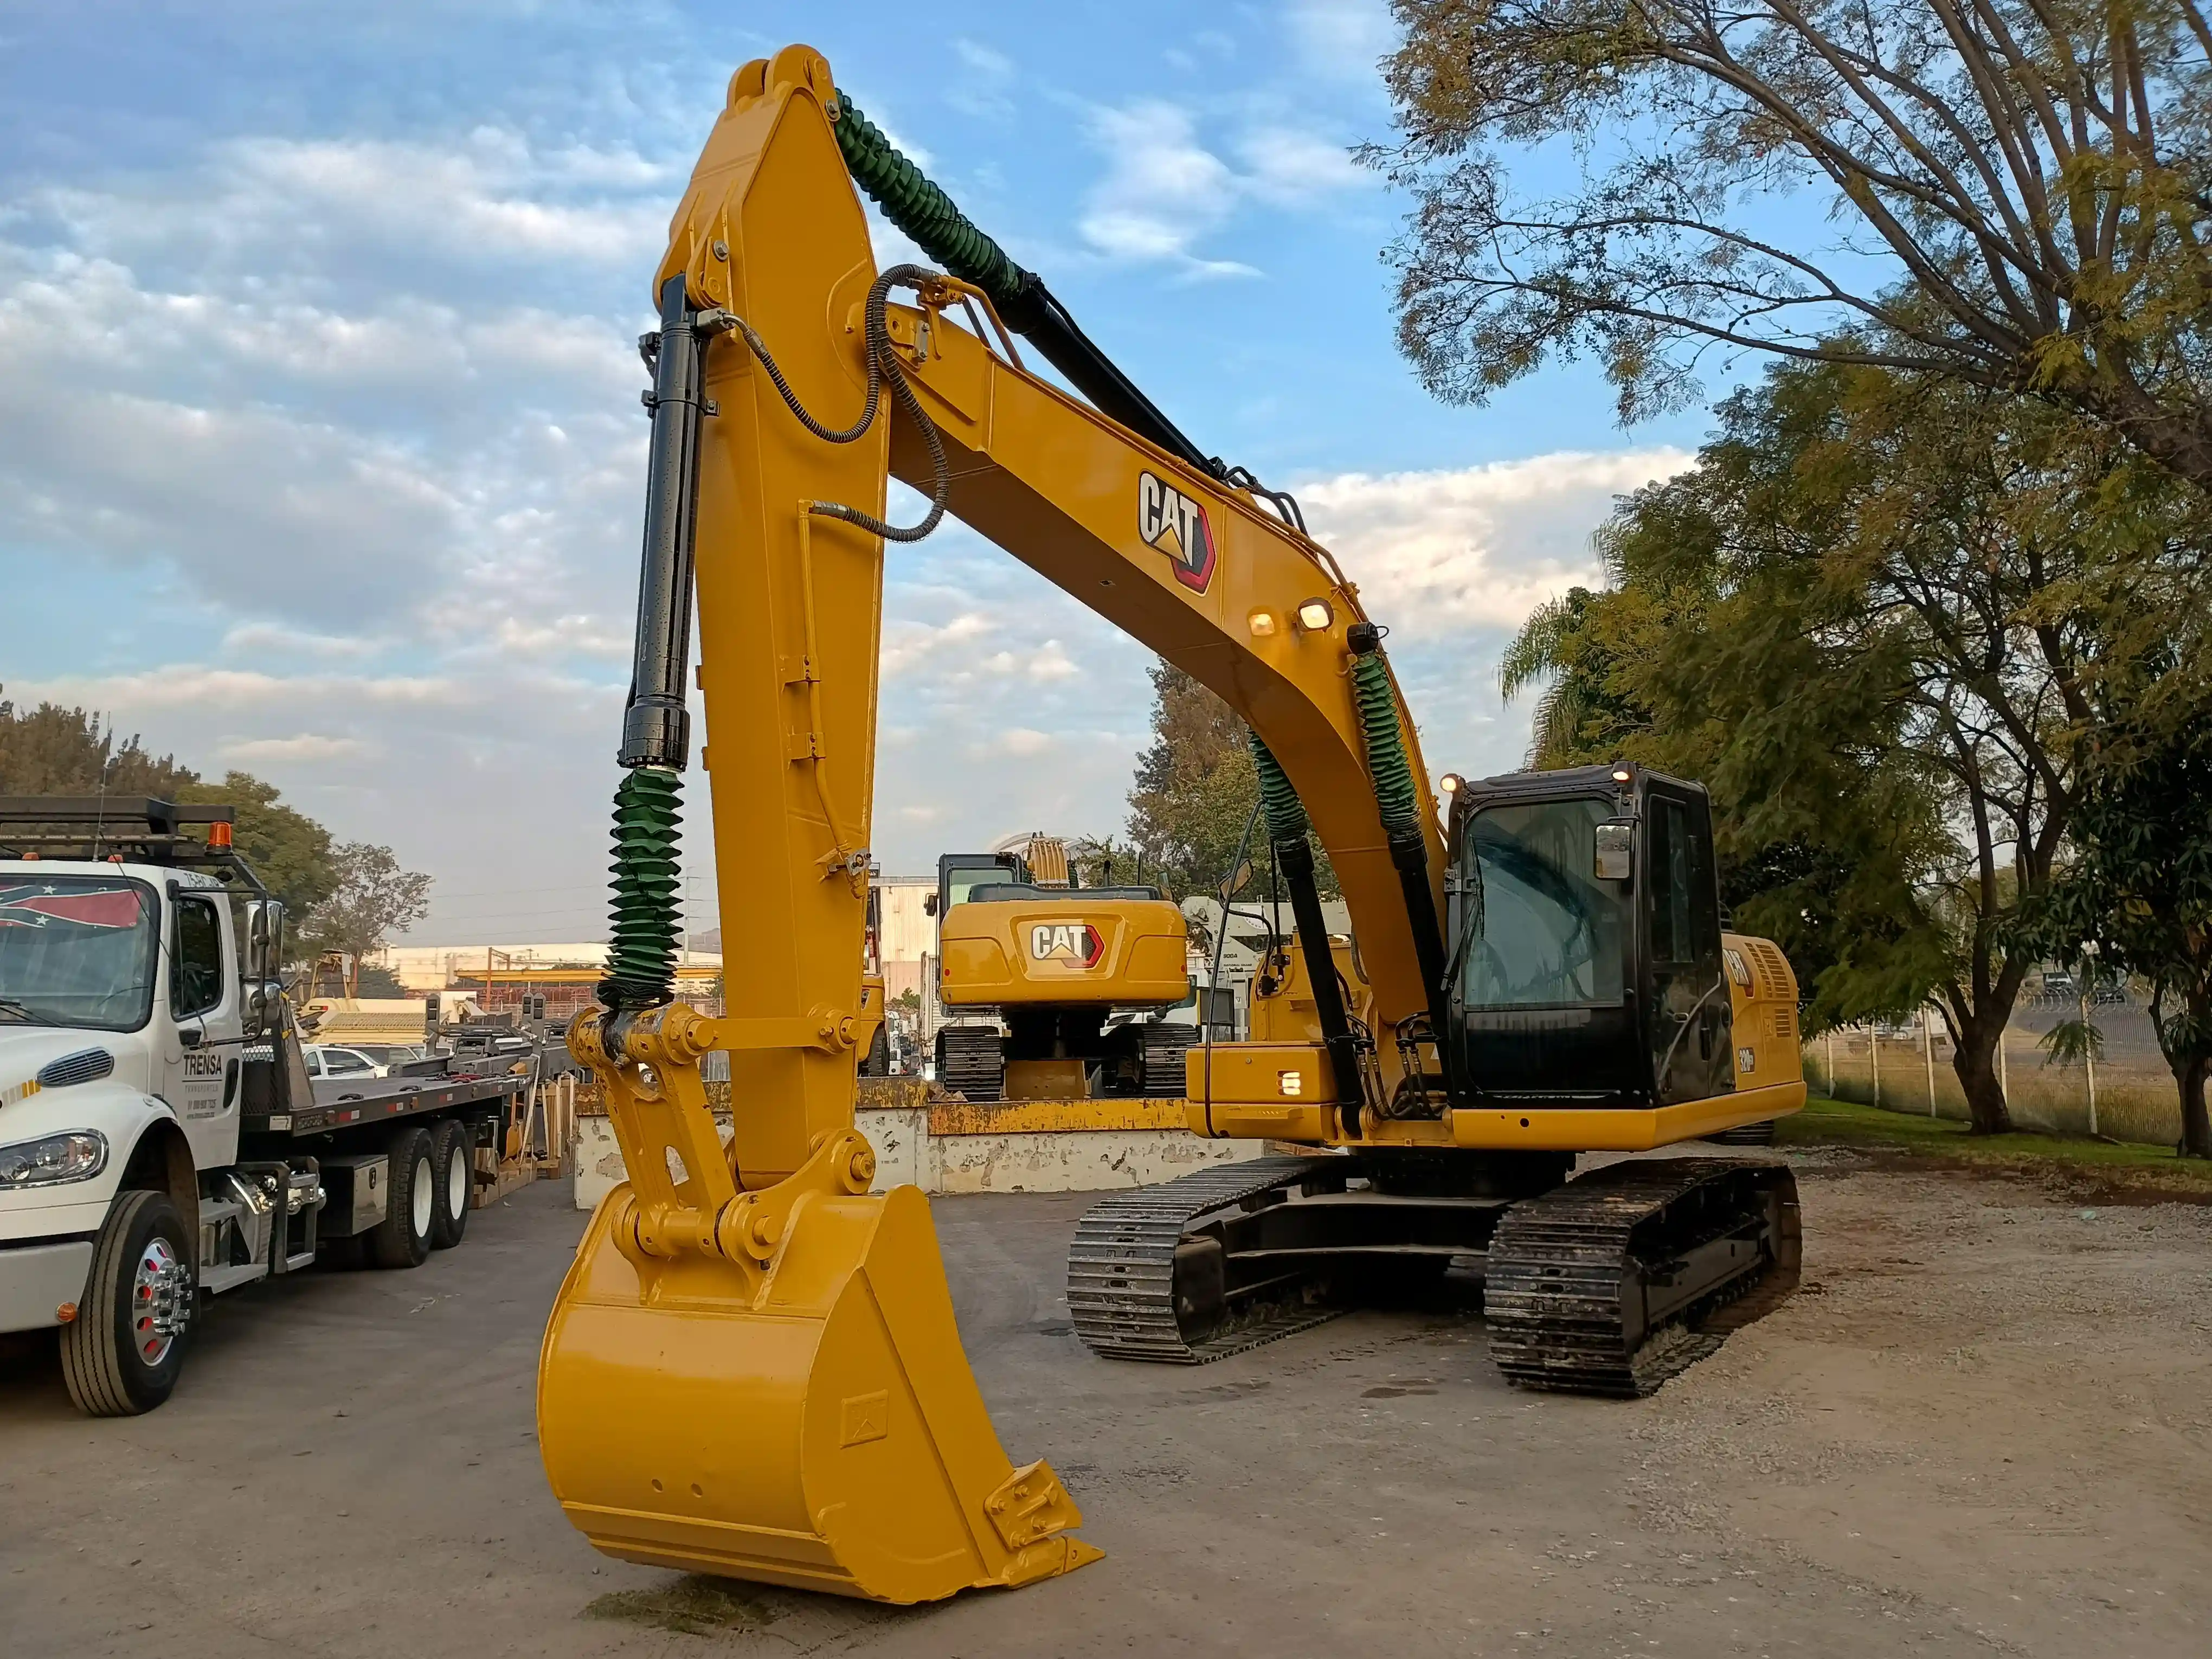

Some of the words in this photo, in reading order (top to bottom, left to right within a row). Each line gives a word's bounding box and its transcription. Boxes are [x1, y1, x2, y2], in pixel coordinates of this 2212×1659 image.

[1140, 473, 1198, 567] CAT
[1032, 926, 1086, 959] CAT
[1723, 949, 1750, 985] CAT
[183, 1054, 222, 1075] TRENSA
